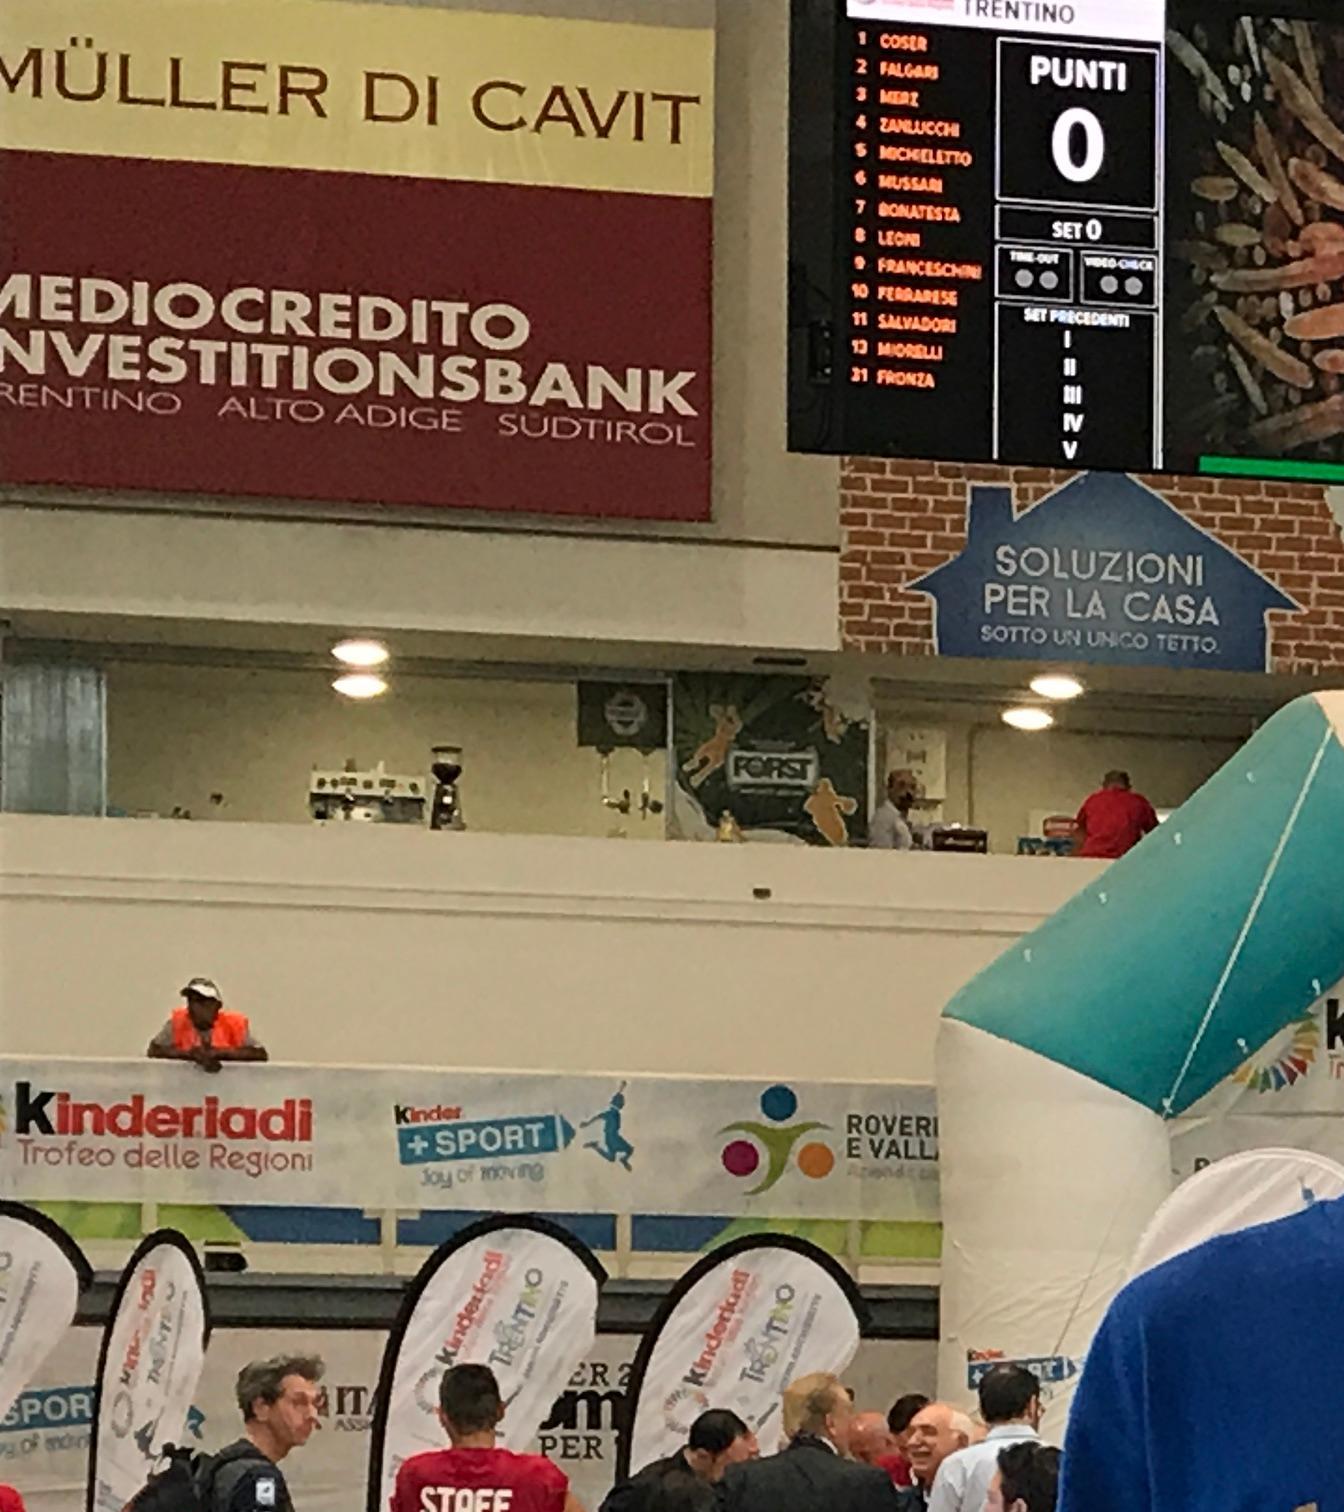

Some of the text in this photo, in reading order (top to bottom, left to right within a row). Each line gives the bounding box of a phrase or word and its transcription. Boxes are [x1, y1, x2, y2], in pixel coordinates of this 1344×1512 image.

[965, 0, 1076, 24] TRENTINO
[857, 31, 929, 52] 1 COSER
[856, 58, 868, 74] 2
[1030, 56, 1127, 93] PUNTI
[0, 37, 702, 146] MÜLLER DI CAVIT
[856, 86, 867, 102] 3
[856, 114, 867, 129] 4
[854, 142, 973, 168] 5 MICHIELETTO
[1051, 107, 1105, 183] 0
[854, 169, 944, 194] 6 MUSSARI
[855, 200, 866, 215] 7
[854, 227, 867, 243] 8
[1052, 218, 1102, 241] SET 0
[854, 256, 867, 270] 9
[851, 285, 869, 299] 10
[852, 312, 868, 326] 11
[1024, 308, 1131, 328] SET PRECEDENTI
[1064, 330, 1071, 348] I
[1063, 358, 1076, 376] II
[1063, 386, 1082, 404] III
[218, 396, 325, 425] ALTO
[334, 403, 463, 433] ADIGE
[498, 410, 696, 447] SÜDTIROL
[1063, 413, 1084, 432] IV
[1062, 441, 1078, 459] V
[995, 544, 1204, 587] SOLUZIONI
[984, 584, 1221, 628] PER LA CASA
[980, 624, 1047, 645] SOTTO
[1053, 628, 1082, 647] UN
[1087, 631, 1149, 651] UNICO
[15, 1081, 313, 1143] Kinderiadi
[394, 1105, 462, 1125] Kinder
[17, 1137, 314, 1178] Trofeo delle Regioni
[847, 1137, 939, 1161] E VALL
[538, 1435, 604, 1460] PER
